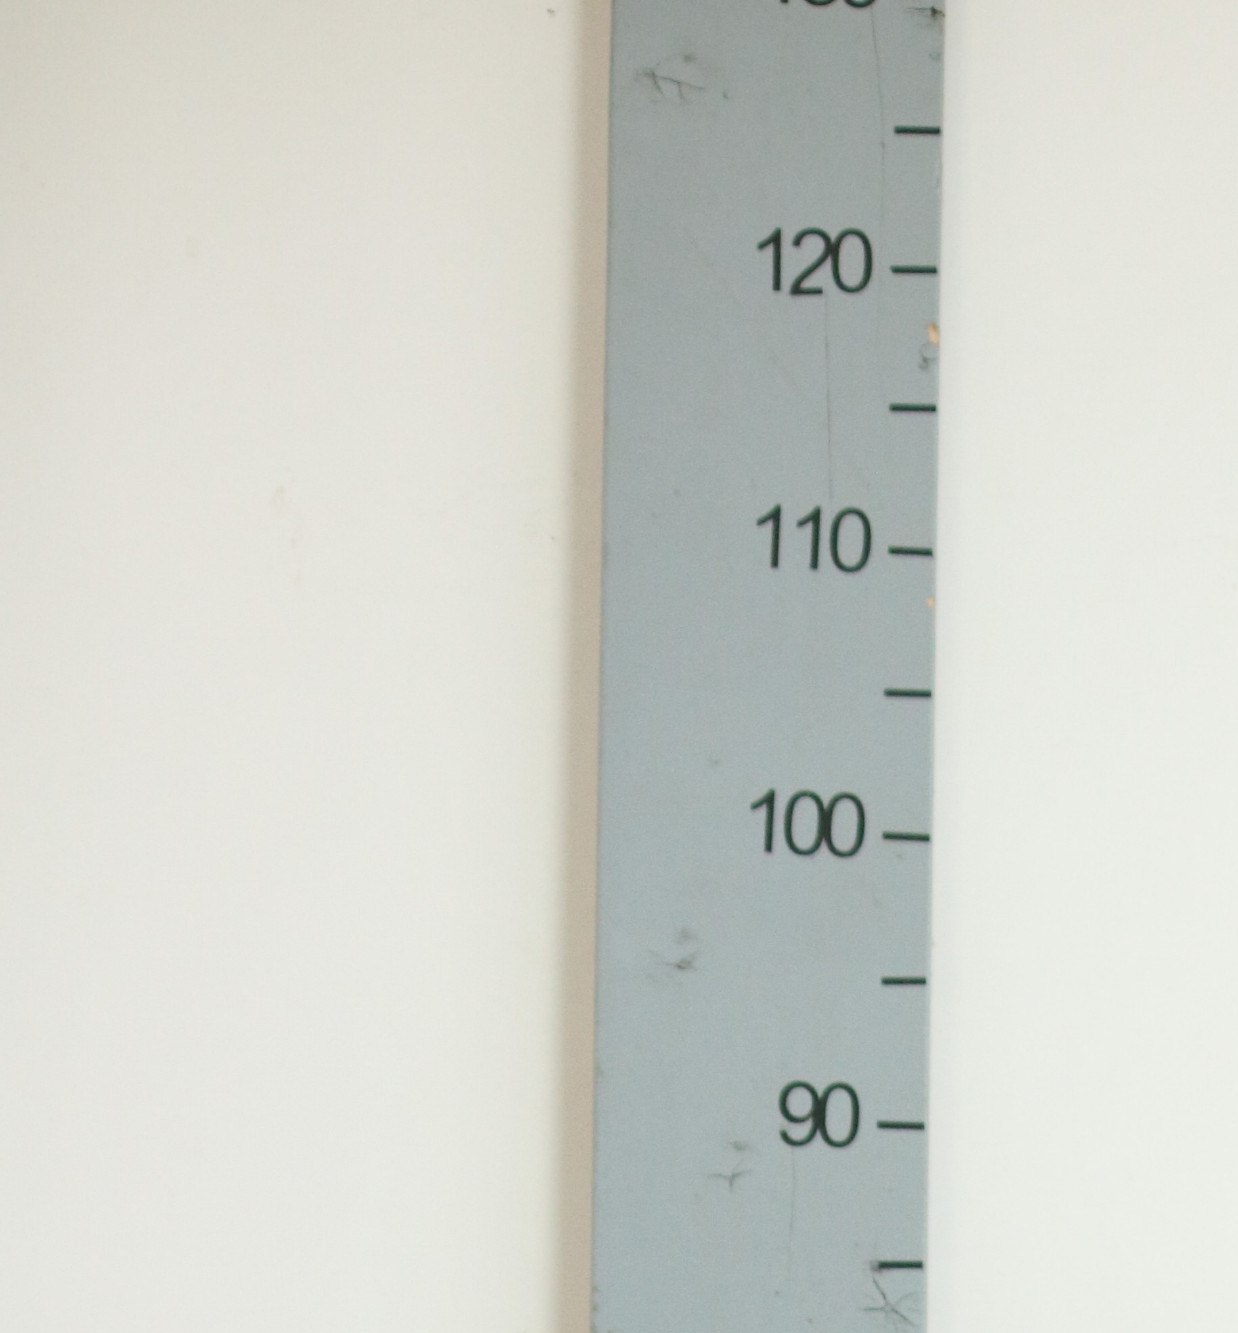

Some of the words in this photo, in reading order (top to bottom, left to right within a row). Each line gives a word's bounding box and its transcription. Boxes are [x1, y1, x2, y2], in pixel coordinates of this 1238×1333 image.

[757, 228, 873, 296] 120
[757, 505, 872, 573] 110
[750, 789, 866, 858] 100
[779, 1081, 860, 1148] 90
